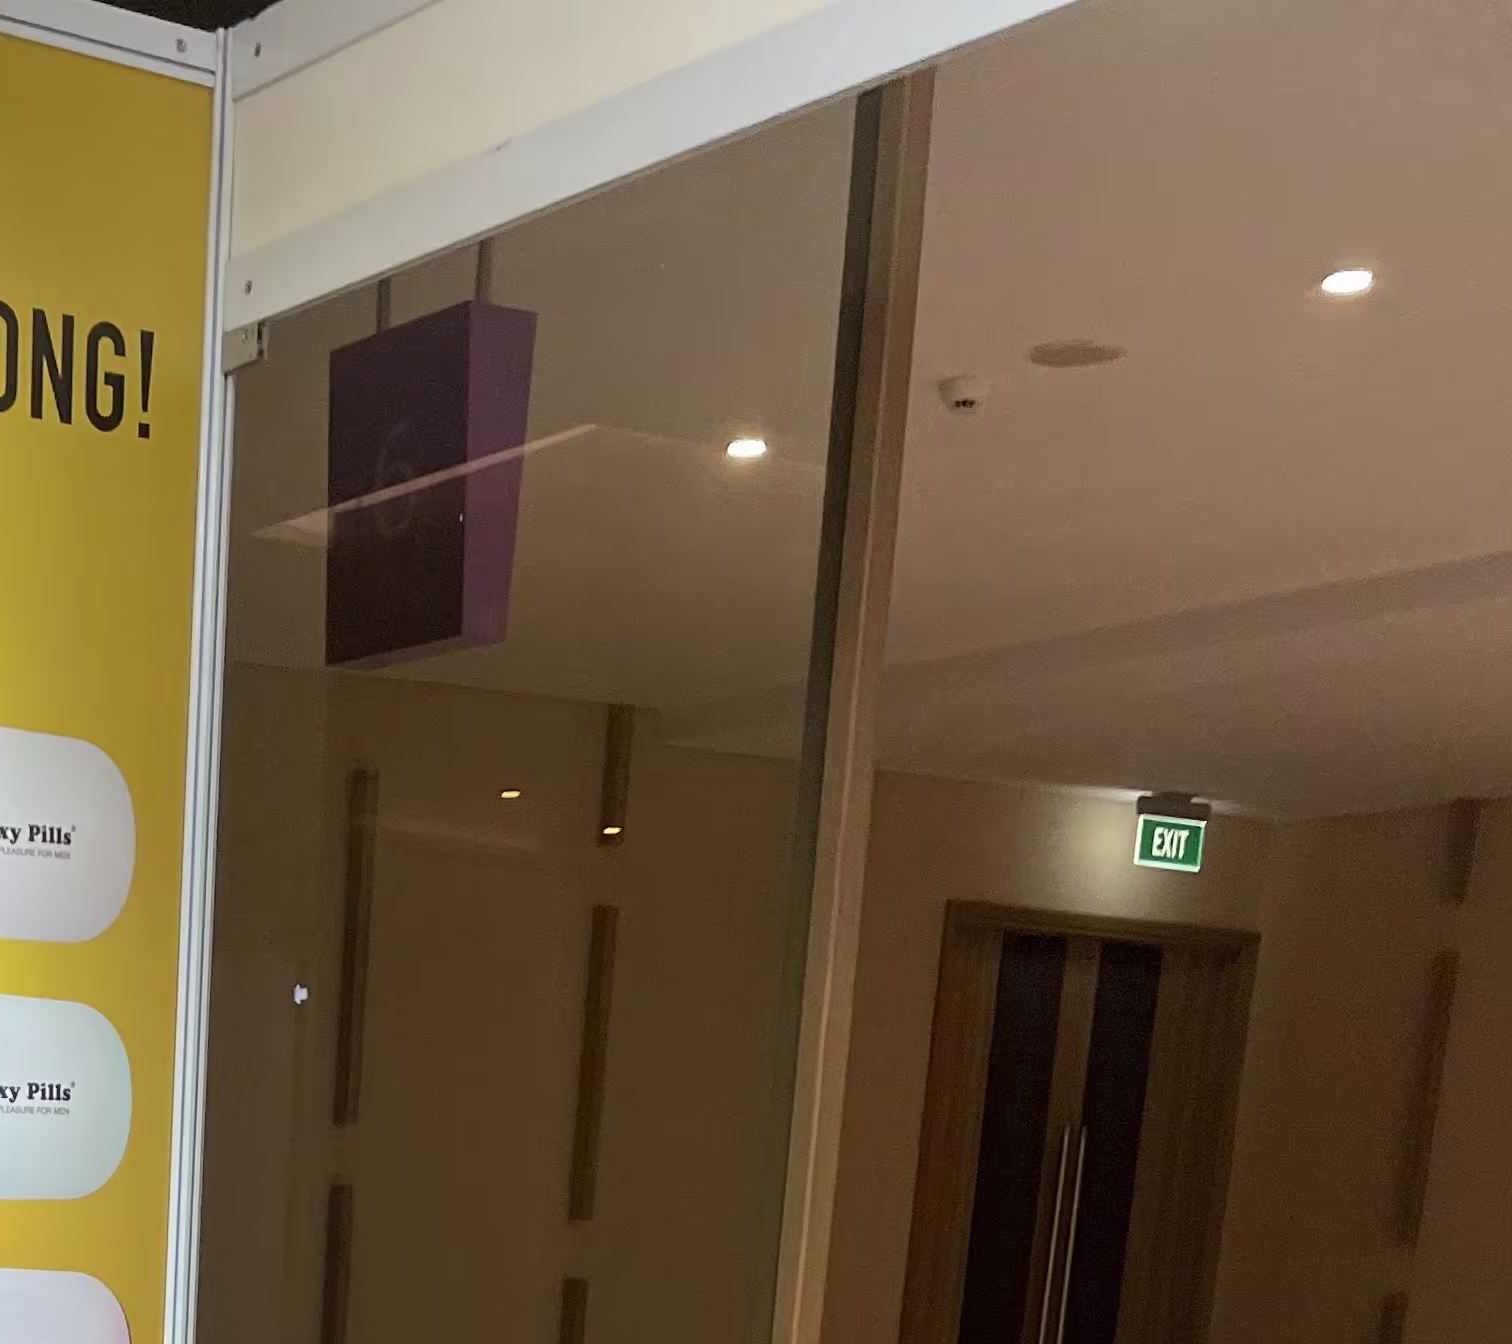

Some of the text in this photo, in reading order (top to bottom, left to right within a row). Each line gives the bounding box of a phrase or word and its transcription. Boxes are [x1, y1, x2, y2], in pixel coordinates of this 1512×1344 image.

[1151, 826, 1190, 860] EXIT
[37, 1106, 52, 1115] FOR
[53, 1107, 70, 1115] MEN
